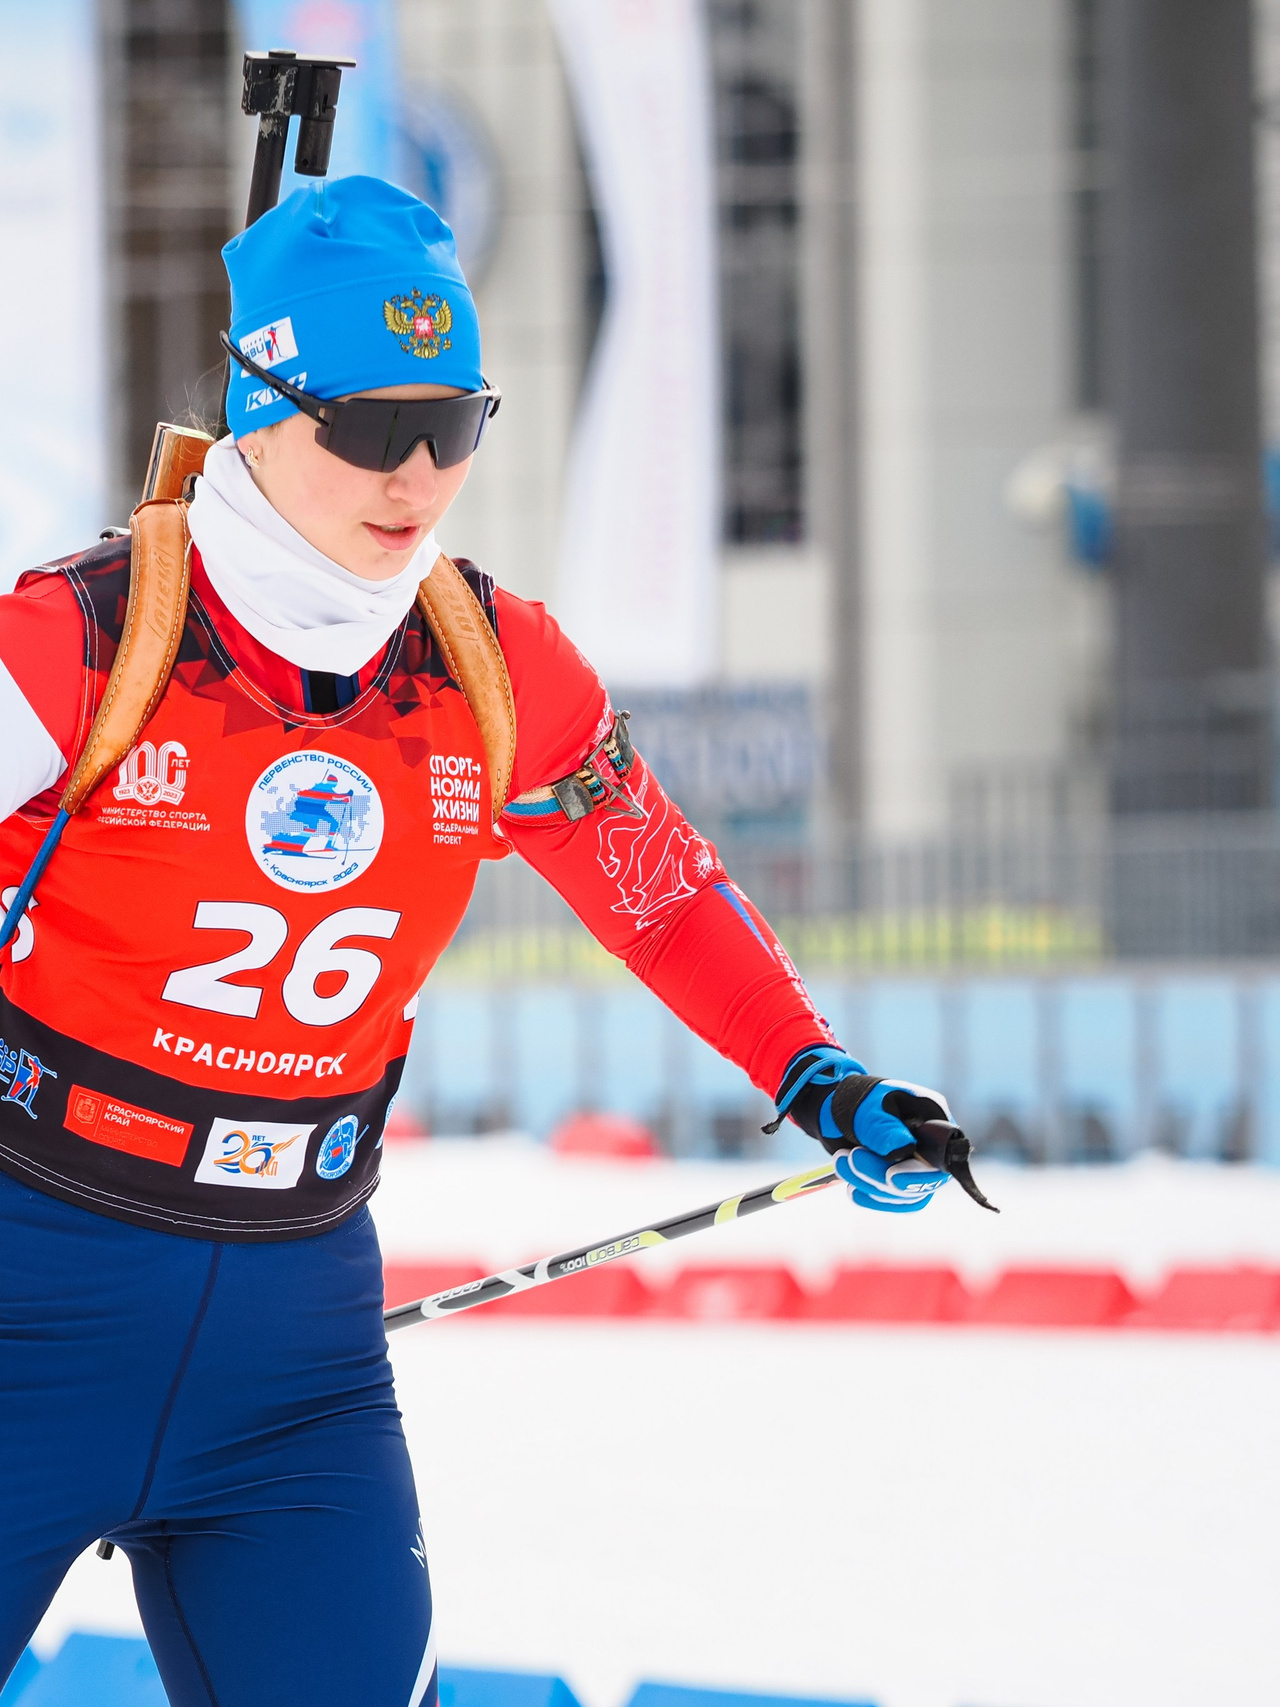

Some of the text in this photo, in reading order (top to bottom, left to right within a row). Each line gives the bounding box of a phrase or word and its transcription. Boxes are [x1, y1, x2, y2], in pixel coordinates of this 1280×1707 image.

[171, 759, 191, 768] ЛЕТ
[429, 755, 473, 777] СПОРТ
[258, 754, 373, 793] ПЕРВЕНСТВО РОССИИ
[163, 789, 178, 799] 2023
[430, 776, 480, 800] НОРМА
[169, 811, 207, 821] СПОРТА
[432, 799, 480, 822] ЖИЗНИ
[149, 820, 211, 832] ФЕДЕРАЦИИ
[433, 822, 479, 835] ФЕДЕРАЛЬНЫЙ
[433, 834, 462, 844] ПРОЕКТ
[270, 864, 328, 888] Красноярск
[333, 862, 359, 882] 2023
[160, 900, 402, 1027] 26
[152, 1027, 347, 1078] КРАСНОЯРСК
[104, 1113, 130, 1127] КРАЙ
[106, 1103, 185, 1134] КРАСНОЯРСКИЙ
[904, 1181, 942, 1193] SKI
[560, 1255, 586, 1274] 100%
